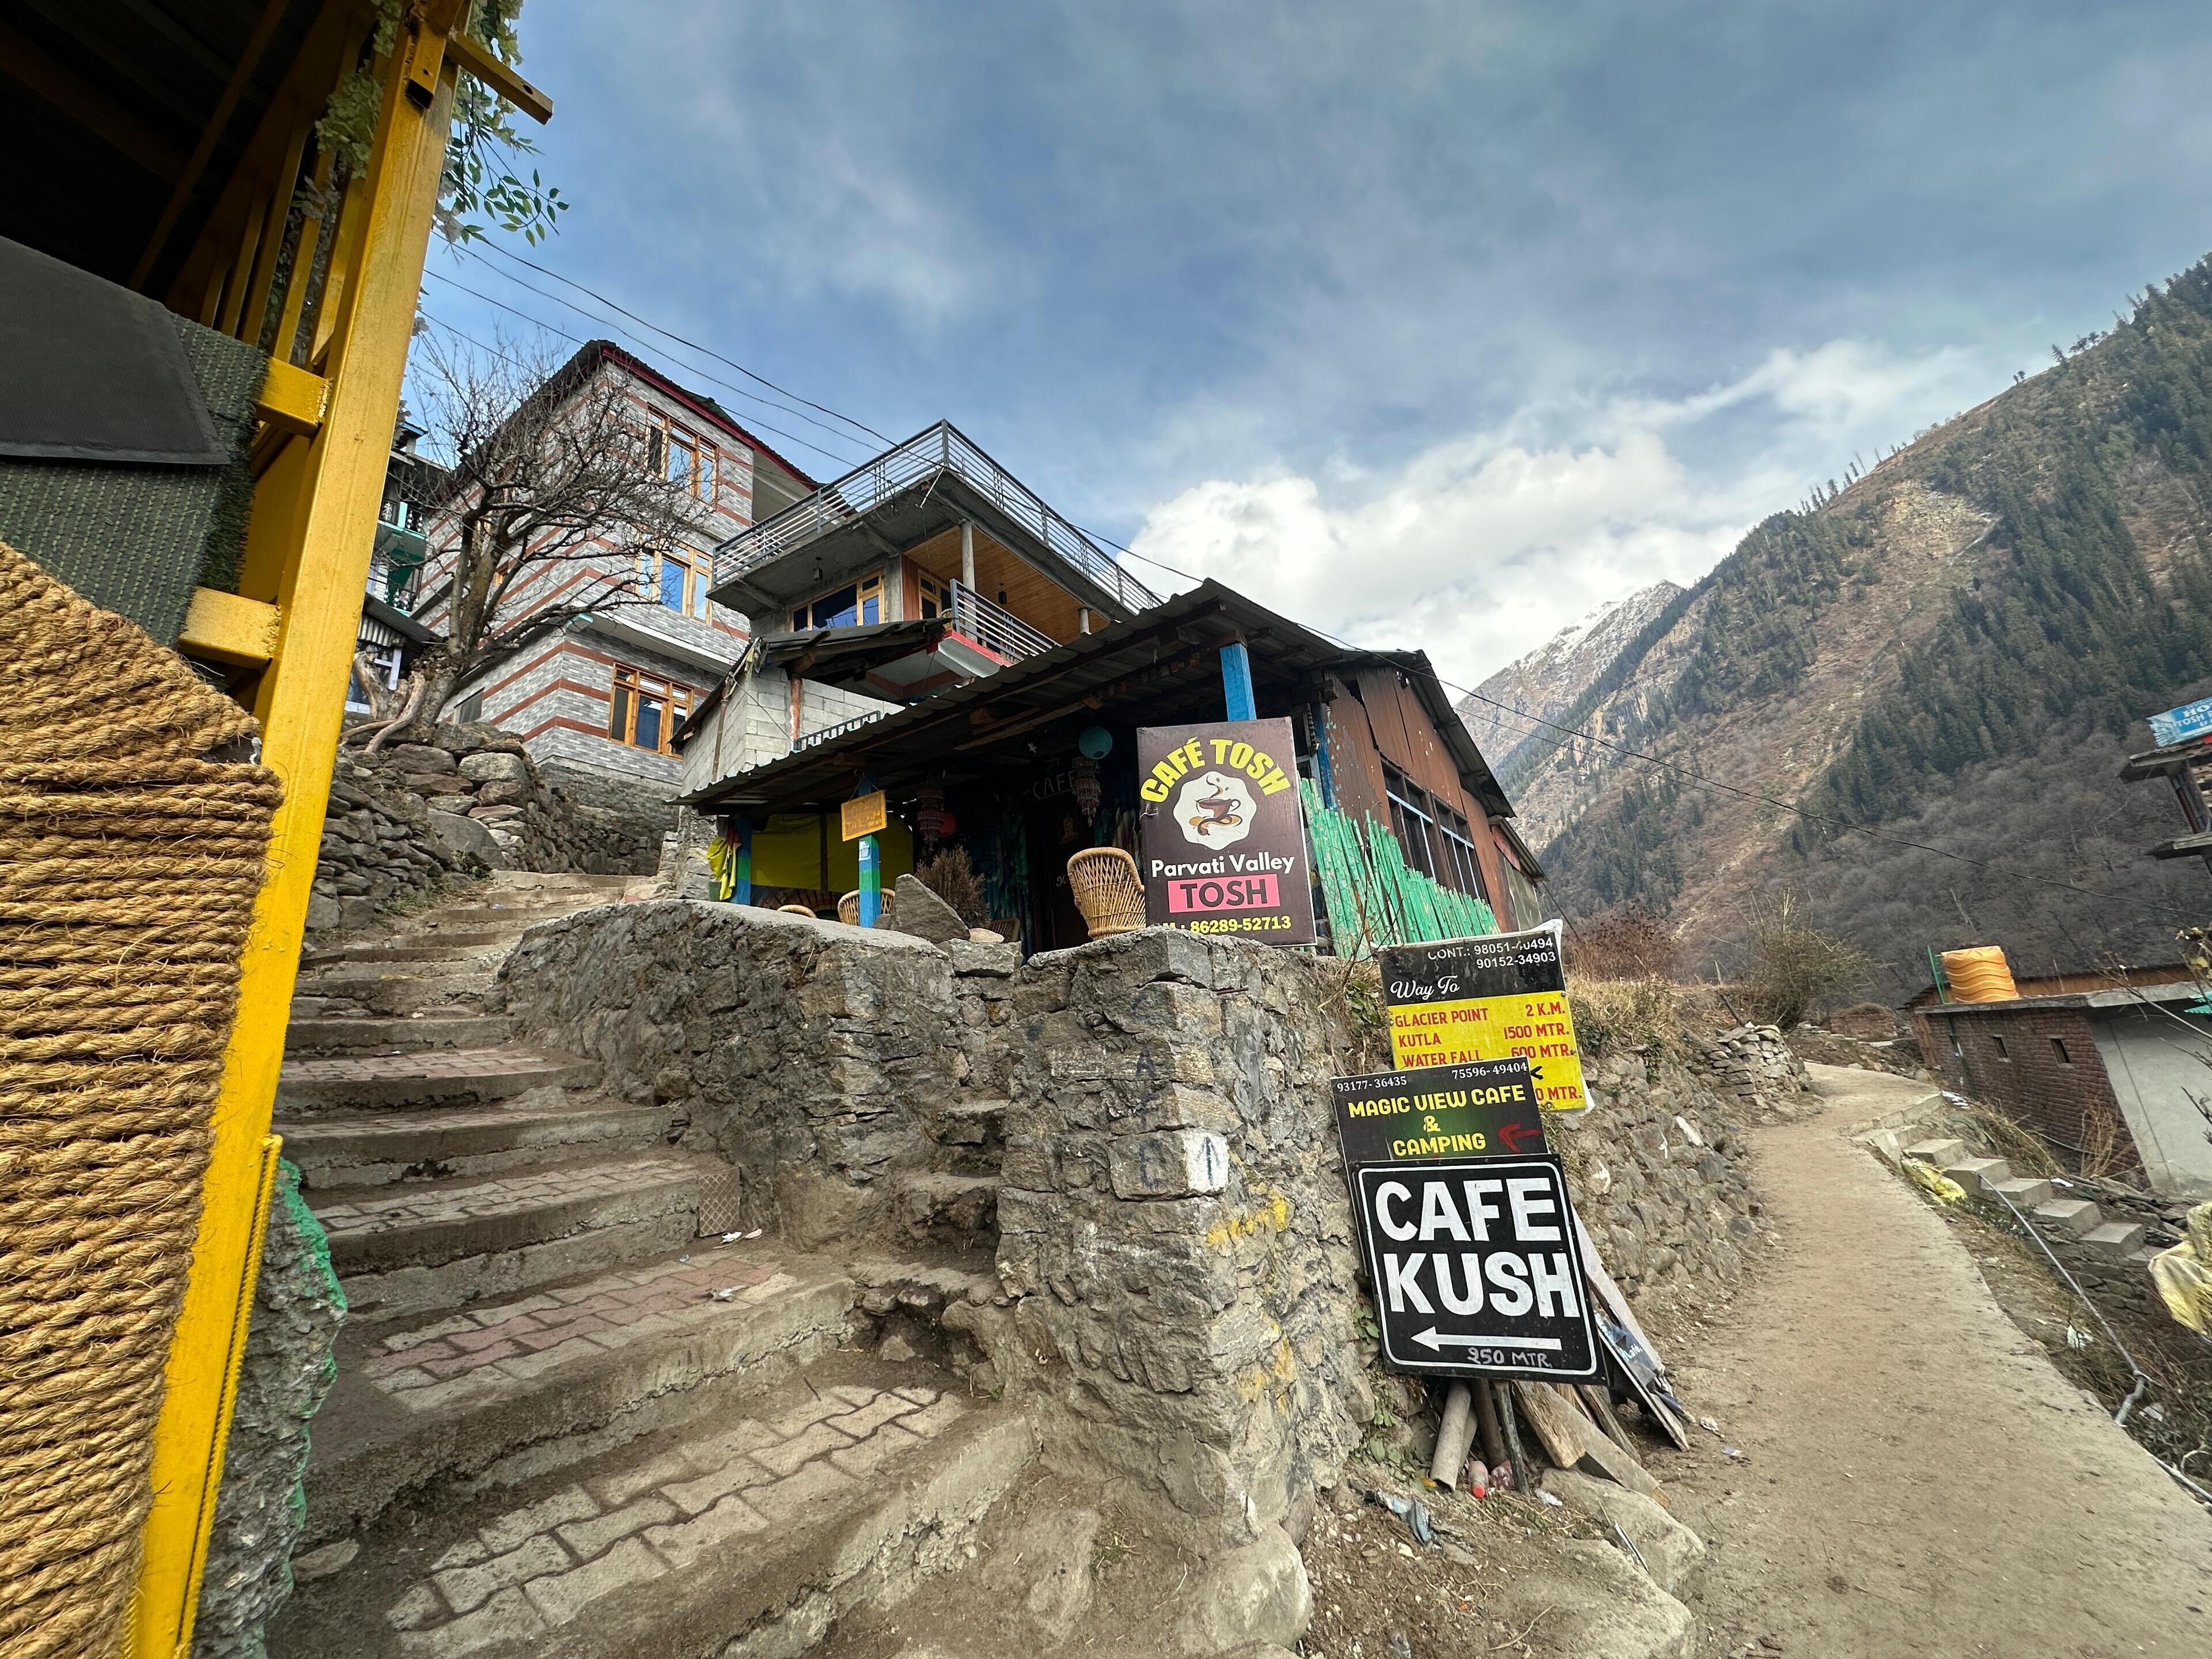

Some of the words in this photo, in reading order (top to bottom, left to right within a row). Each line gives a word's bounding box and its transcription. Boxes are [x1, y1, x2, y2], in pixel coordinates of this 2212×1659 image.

[2176, 713, 2205, 726] TOSH
[2183, 703, 2212, 717] HO
[1141, 737, 1205, 802] CAFÉ
[1210, 739, 1291, 796] TOSH
[1152, 855, 1225, 877] Parvati
[1229, 852, 1295, 874] Valley
[1180, 879, 1267, 908] TOSH
[1190, 915, 1291, 934] 86289-52713
[1476, 951, 1556, 969] 90152-34903
[1390, 980, 1434, 1000] Way
[1438, 975, 1460, 994] To
[1395, 1011, 1447, 1028] GLACIER
[1451, 1008, 1488, 1023] POINT
[1525, 1004, 1534, 1017] 2
[1537, 1001, 1566, 1016] K.M.
[1398, 1032, 1442, 1047] KUTLA
[1503, 1025, 1532, 1039] 1500
[1535, 1022, 1570, 1036] MTR.
[1402, 1052, 1449, 1067] WATER
[1450, 1049, 1483, 1064] FALL
[1511, 1046, 1535, 1059] 600
[1539, 1043, 1573, 1058] MTR.
[1347, 1096, 1411, 1119] MAGIC
[1414, 1090, 1467, 1111] VIEW
[1471, 1084, 1526, 1105] CAFE
[1547, 1086, 1582, 1100] MTR.
[1423, 1116, 1441, 1132] &
[1393, 1134, 1486, 1157] CAMPING
[1374, 1177, 1562, 1243] CAFE
[1382, 1251, 1581, 1318] KUSH
